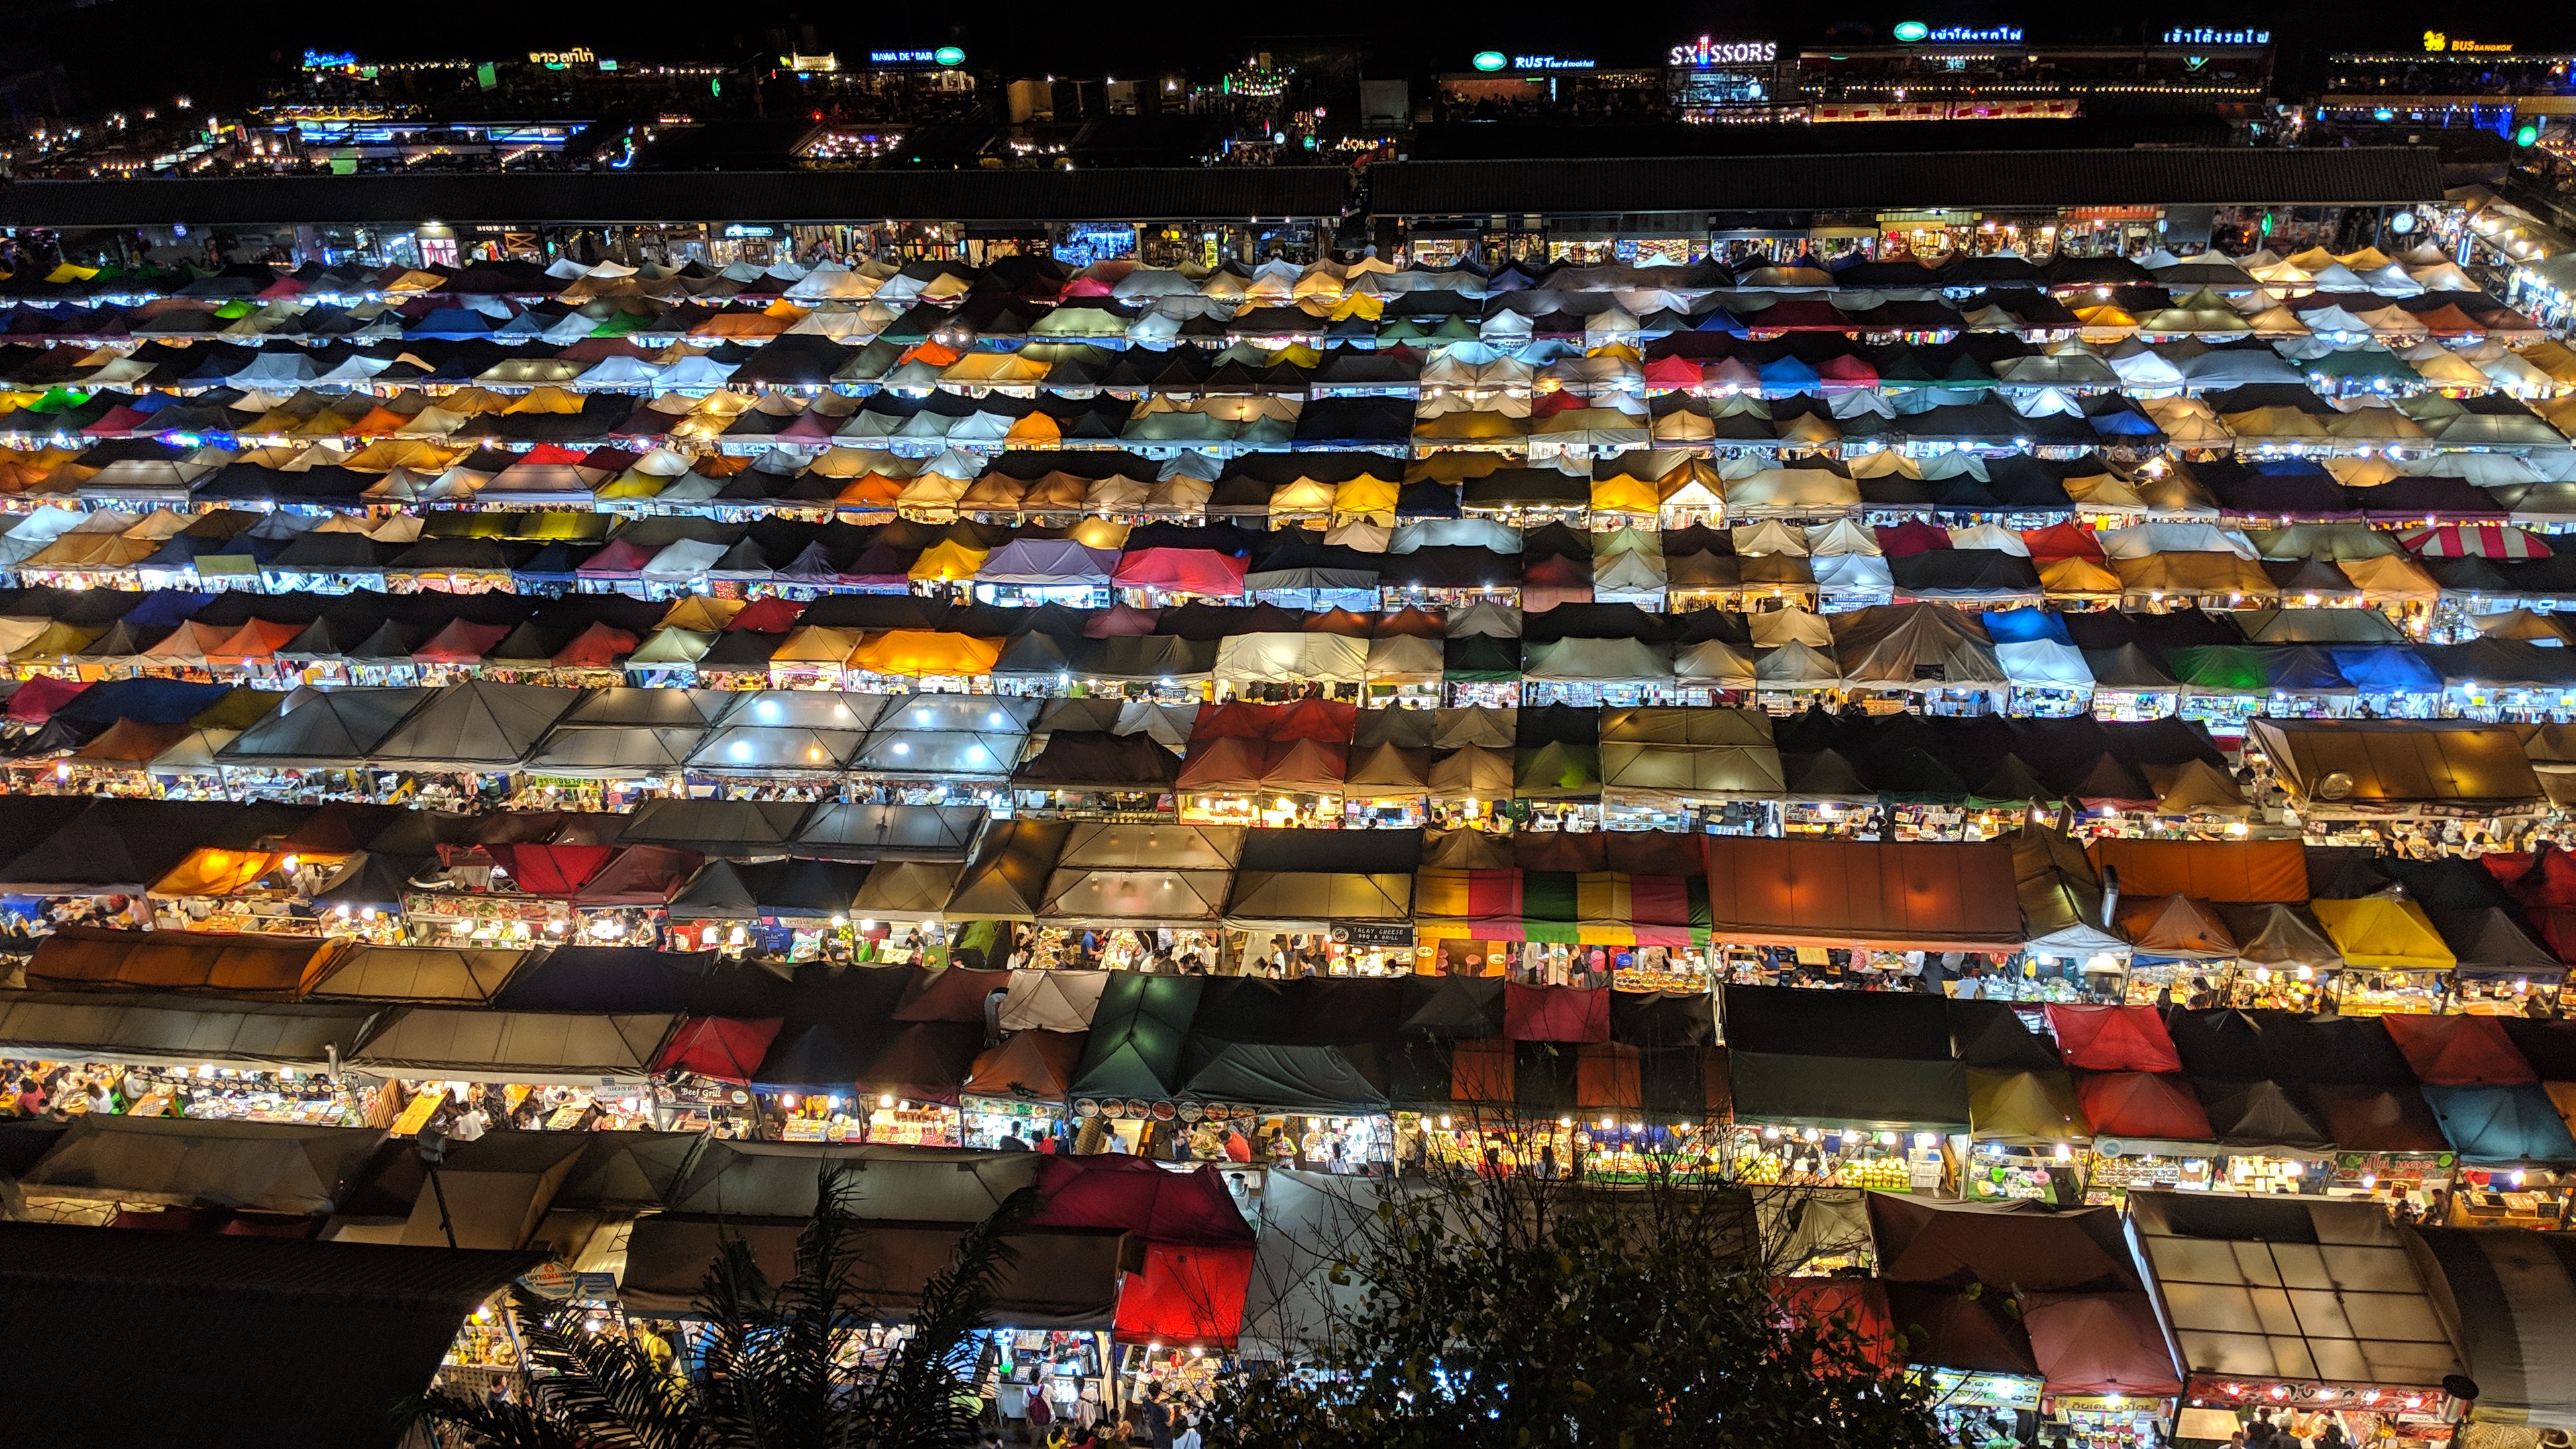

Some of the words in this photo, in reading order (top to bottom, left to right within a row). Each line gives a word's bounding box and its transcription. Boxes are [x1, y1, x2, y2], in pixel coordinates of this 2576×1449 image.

[2451, 40, 2475, 52] BUS
[871, 52, 898, 61] NAWA
[915, 52, 933, 60] BAR
[1515, 56, 1554, 68] RUST
[681, 1087, 700, 1097] Beef
[702, 1089, 721, 1098] Grill
